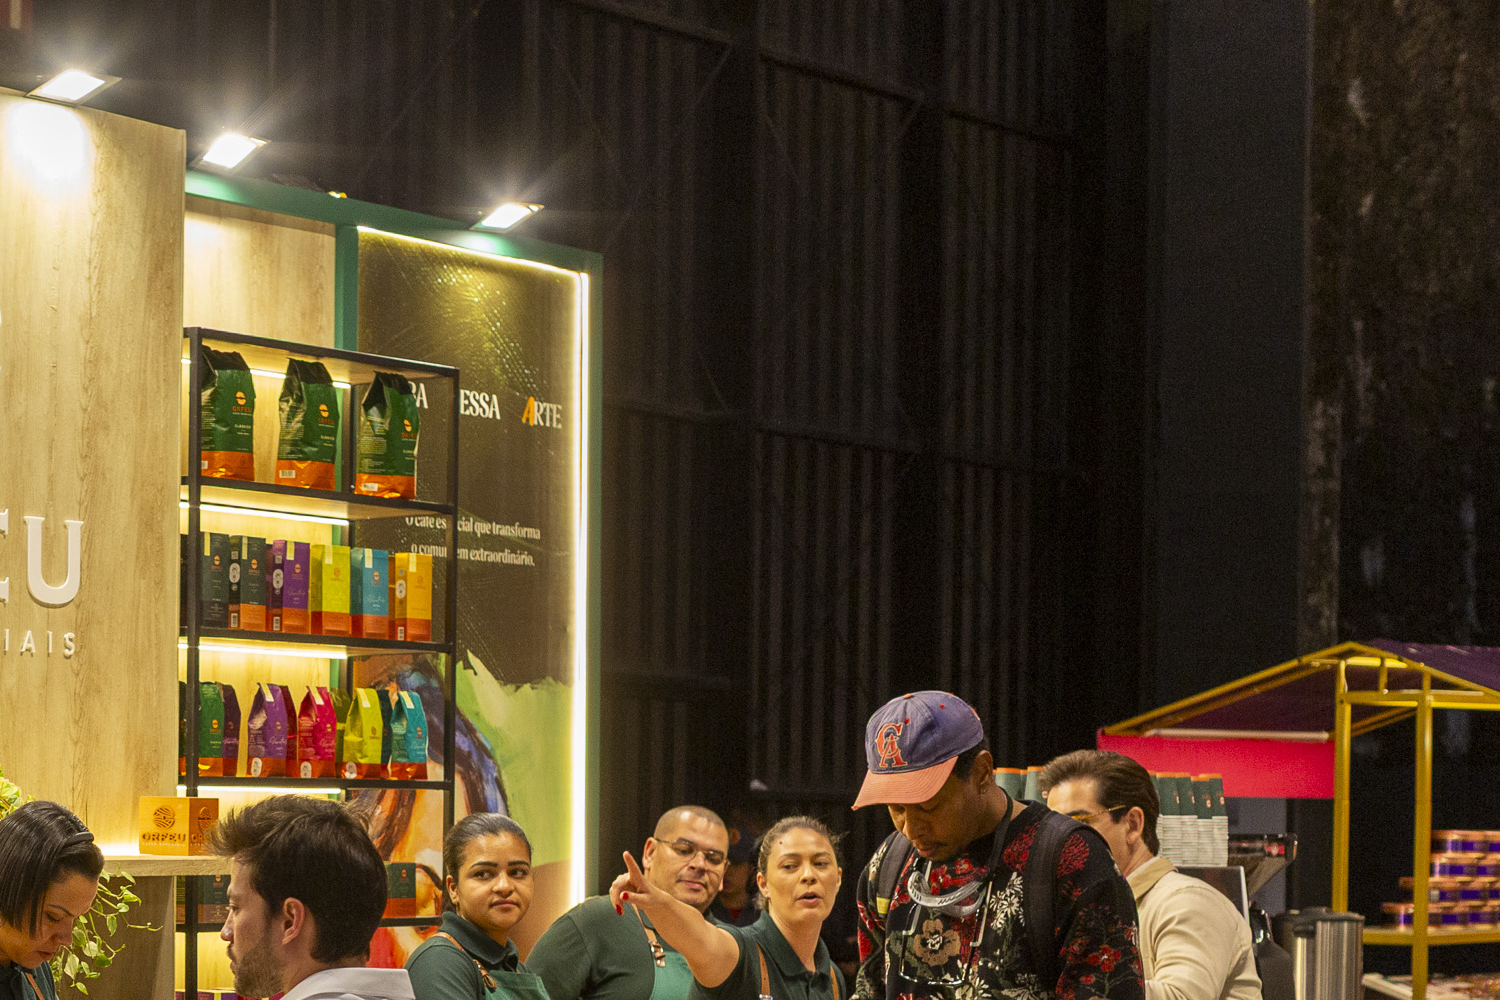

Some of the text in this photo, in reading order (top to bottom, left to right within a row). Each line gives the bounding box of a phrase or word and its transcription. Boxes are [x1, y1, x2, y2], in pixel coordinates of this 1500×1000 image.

[459, 389, 501, 420] ESSA
[522, 396, 563, 429] ARTE
[475, 521, 491, 537] que
[492, 522, 541, 540] transforma
[142, 833, 187, 843] ORFEU
